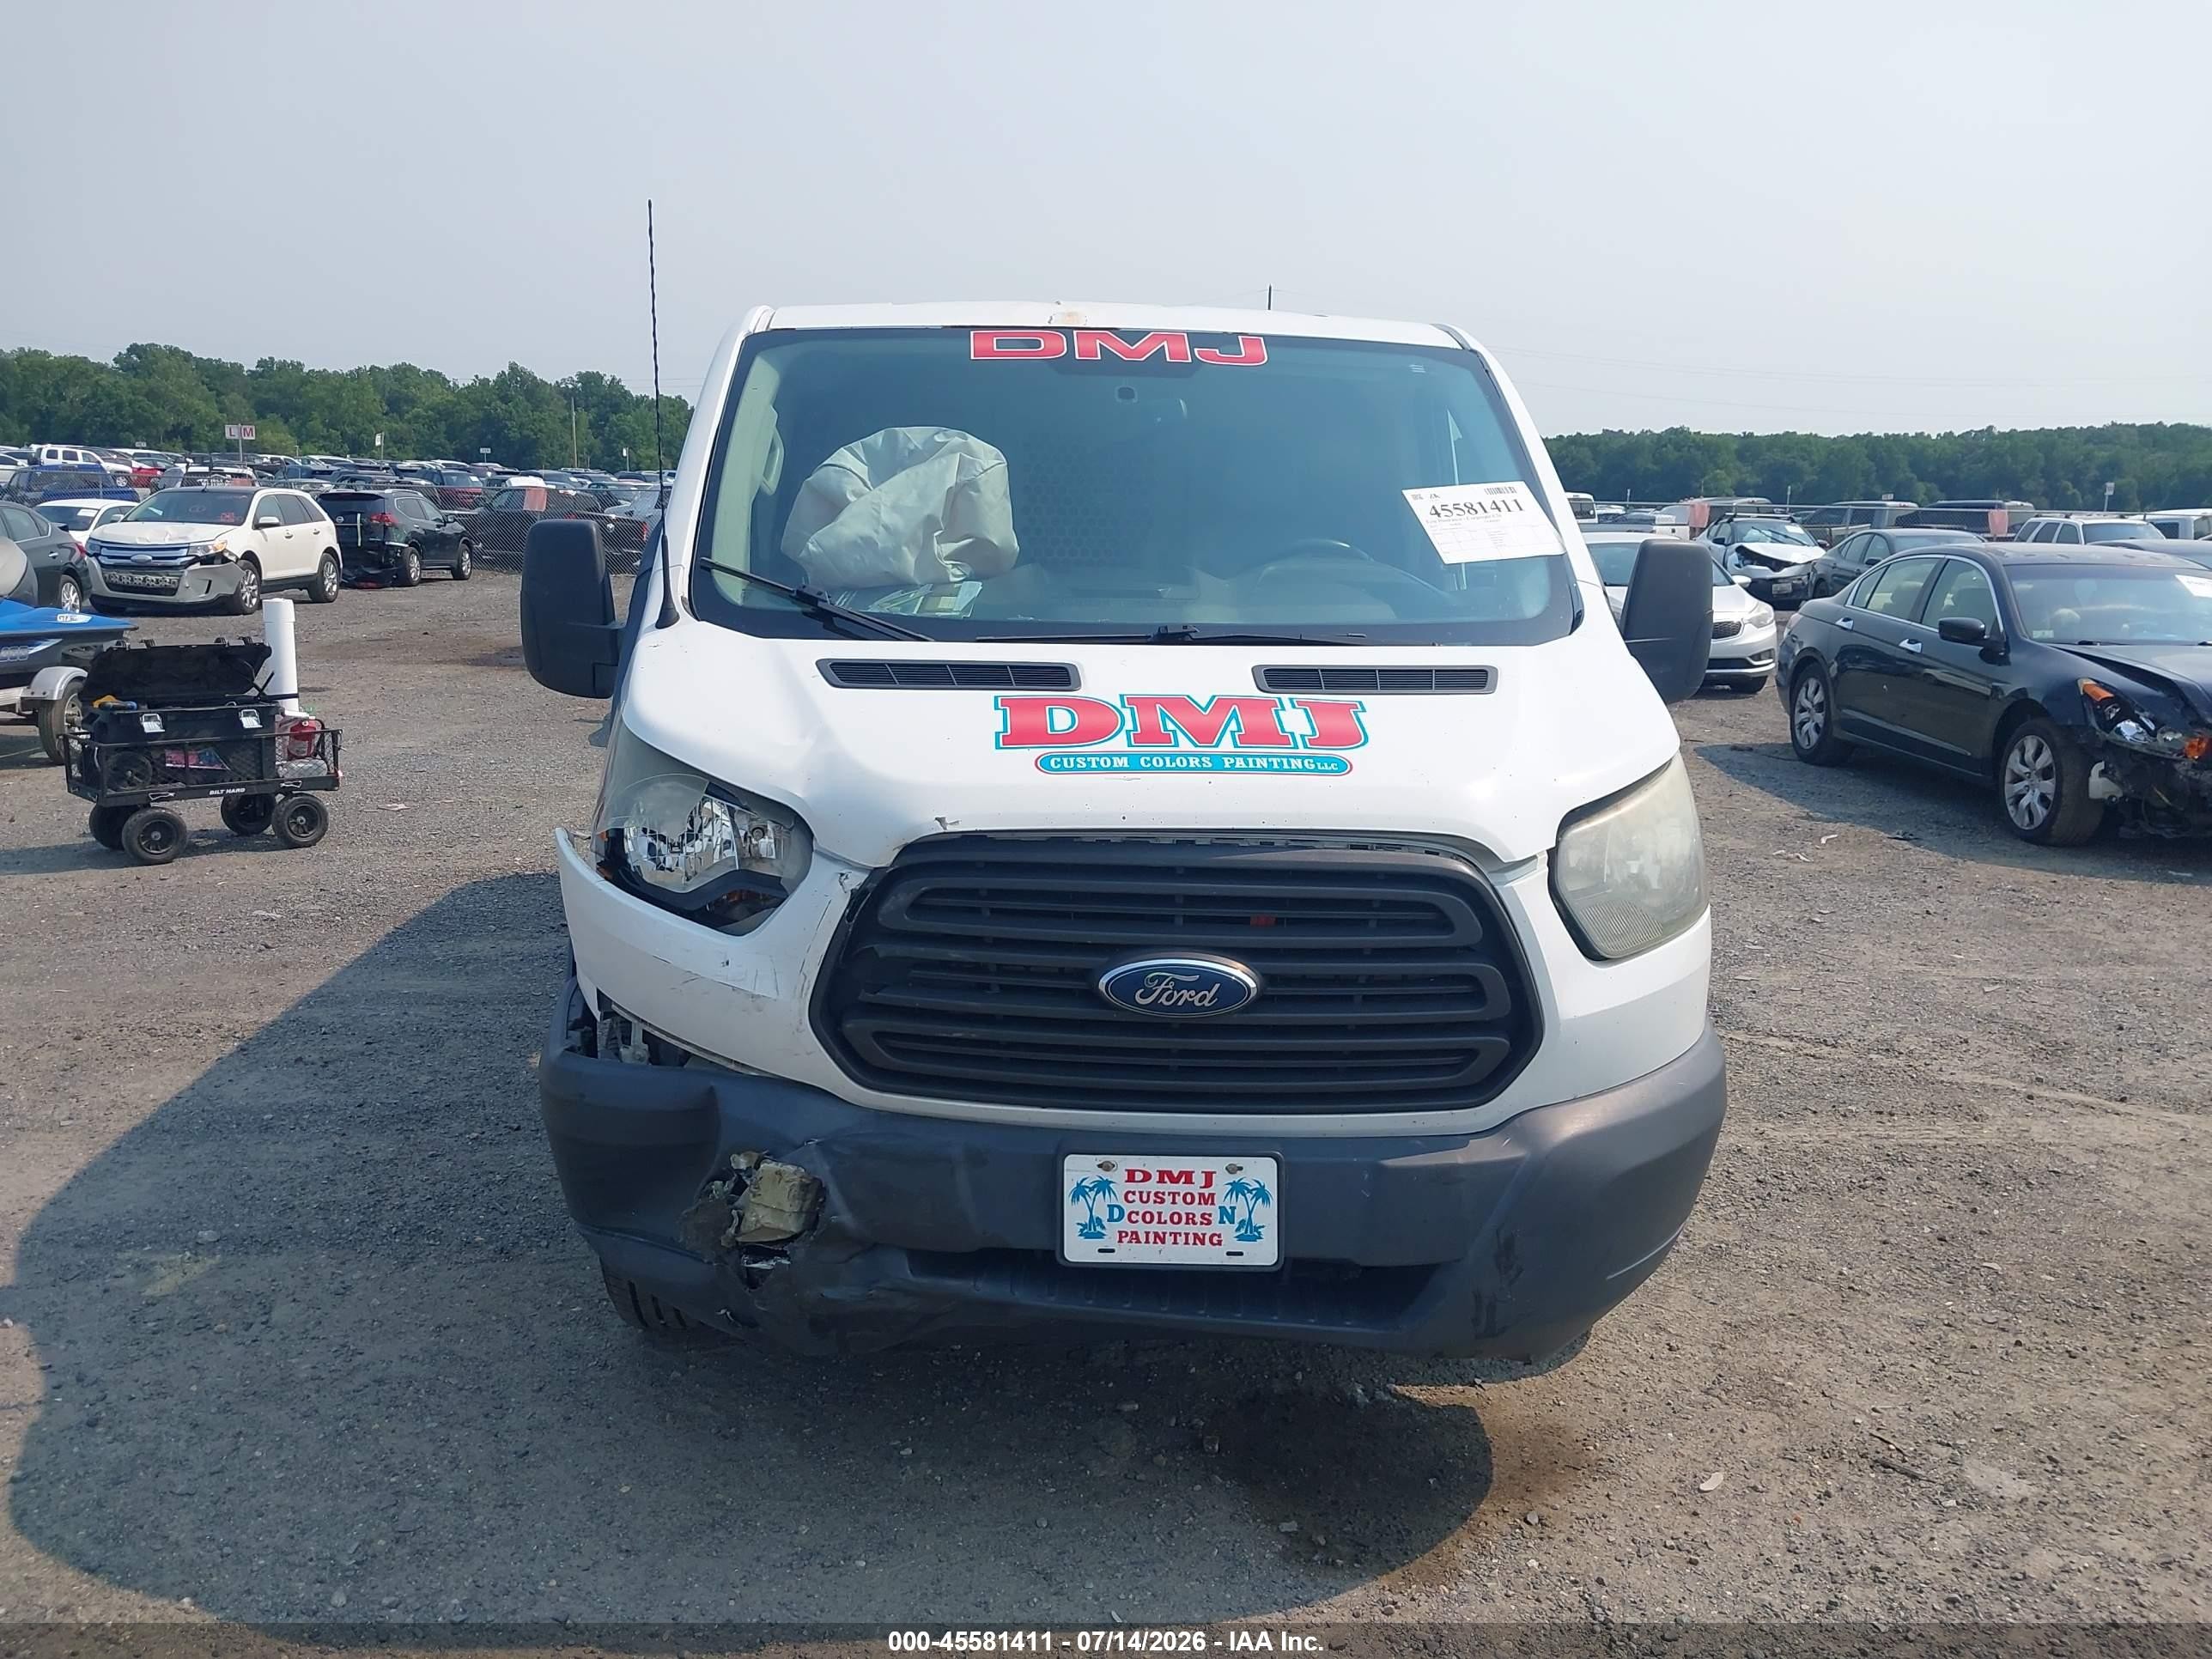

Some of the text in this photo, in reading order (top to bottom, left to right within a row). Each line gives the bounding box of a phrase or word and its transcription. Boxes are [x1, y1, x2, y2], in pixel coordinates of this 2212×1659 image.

[970, 330, 1268, 366] DMJ
[228, 427, 236, 437] L
[242, 427, 254, 437] M
[1429, 498, 1526, 519] 45581411
[994, 693, 1369, 750] DMJ
[1049, 756, 1339, 771] CUSTOM COLORS PAINTING LLC
[1134, 971, 1221, 1007] Ford
[1124, 1169, 1217, 1188] DMJ
[1123, 1190, 1216, 1206] CUSTOM
[1106, 1204, 1237, 1225] D COLORS N
[1117, 1230, 1224, 1246] PAINTING
